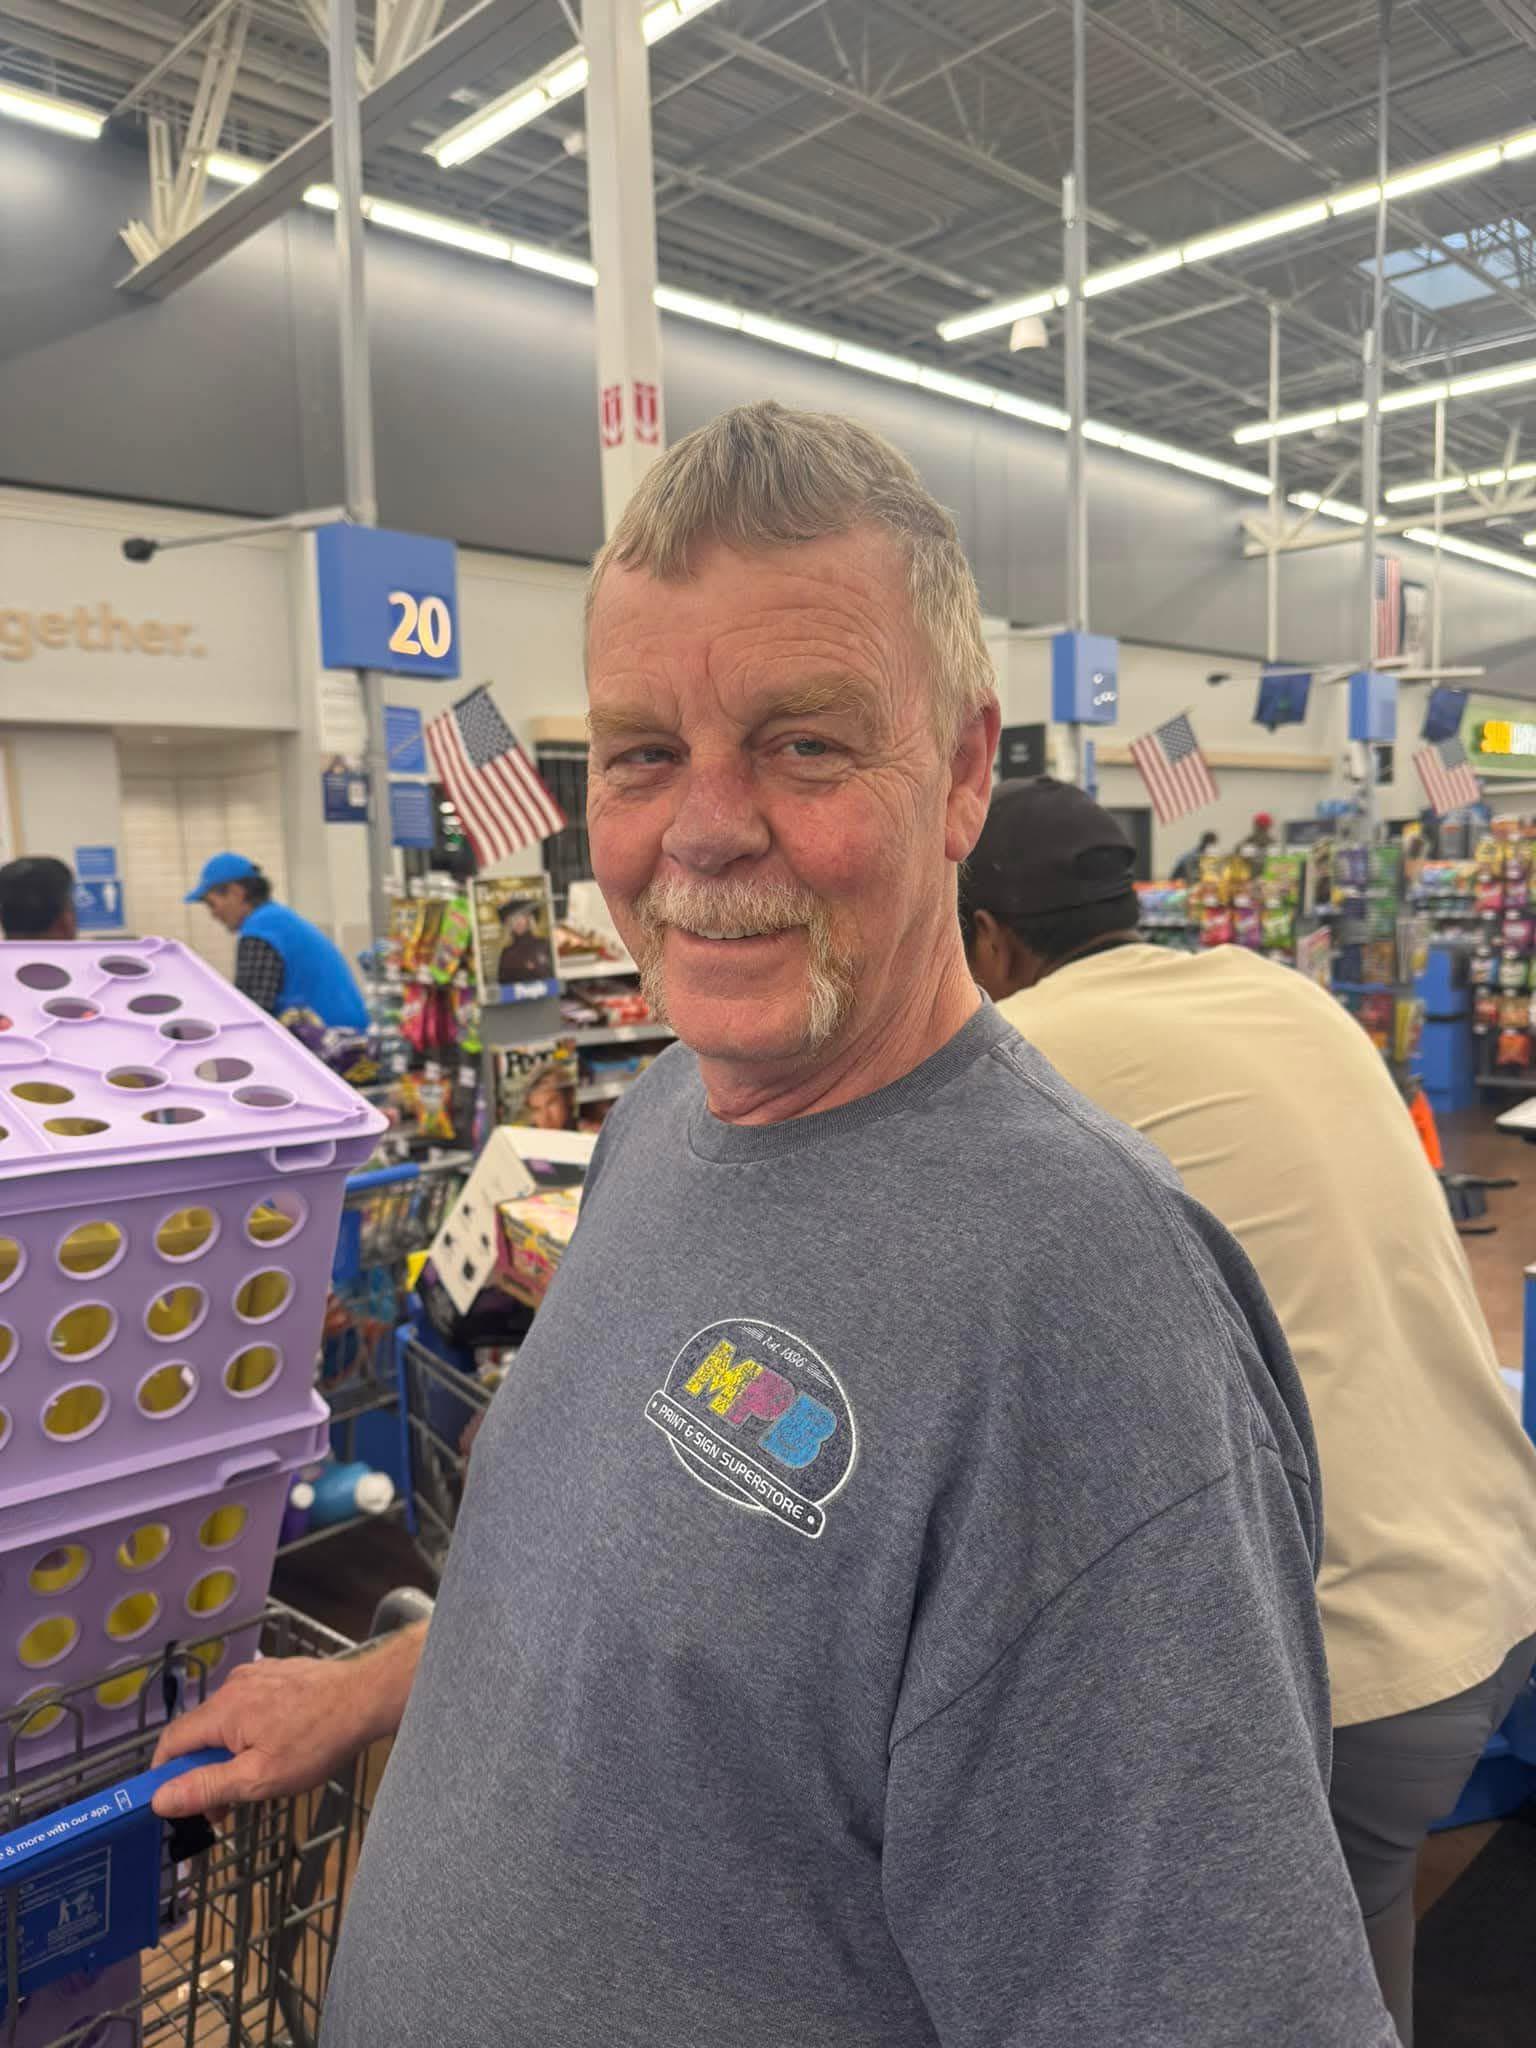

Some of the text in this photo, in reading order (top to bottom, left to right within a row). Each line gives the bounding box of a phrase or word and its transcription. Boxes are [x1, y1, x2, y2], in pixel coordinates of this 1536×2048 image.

[388, 591, 452, 659] 20
[780, 1347, 808, 1368] 1896
[685, 1339, 838, 1470] MPB
[658, 1404, 805, 1520] PRINT & SIGN SUPERSTORE
[5, 1846, 16, 1857] &
[16, 1833, 46, 1852] more
[46, 1821, 71, 1838] with
[71, 1812, 90, 1827] our
[90, 1803, 113, 1820] app.
